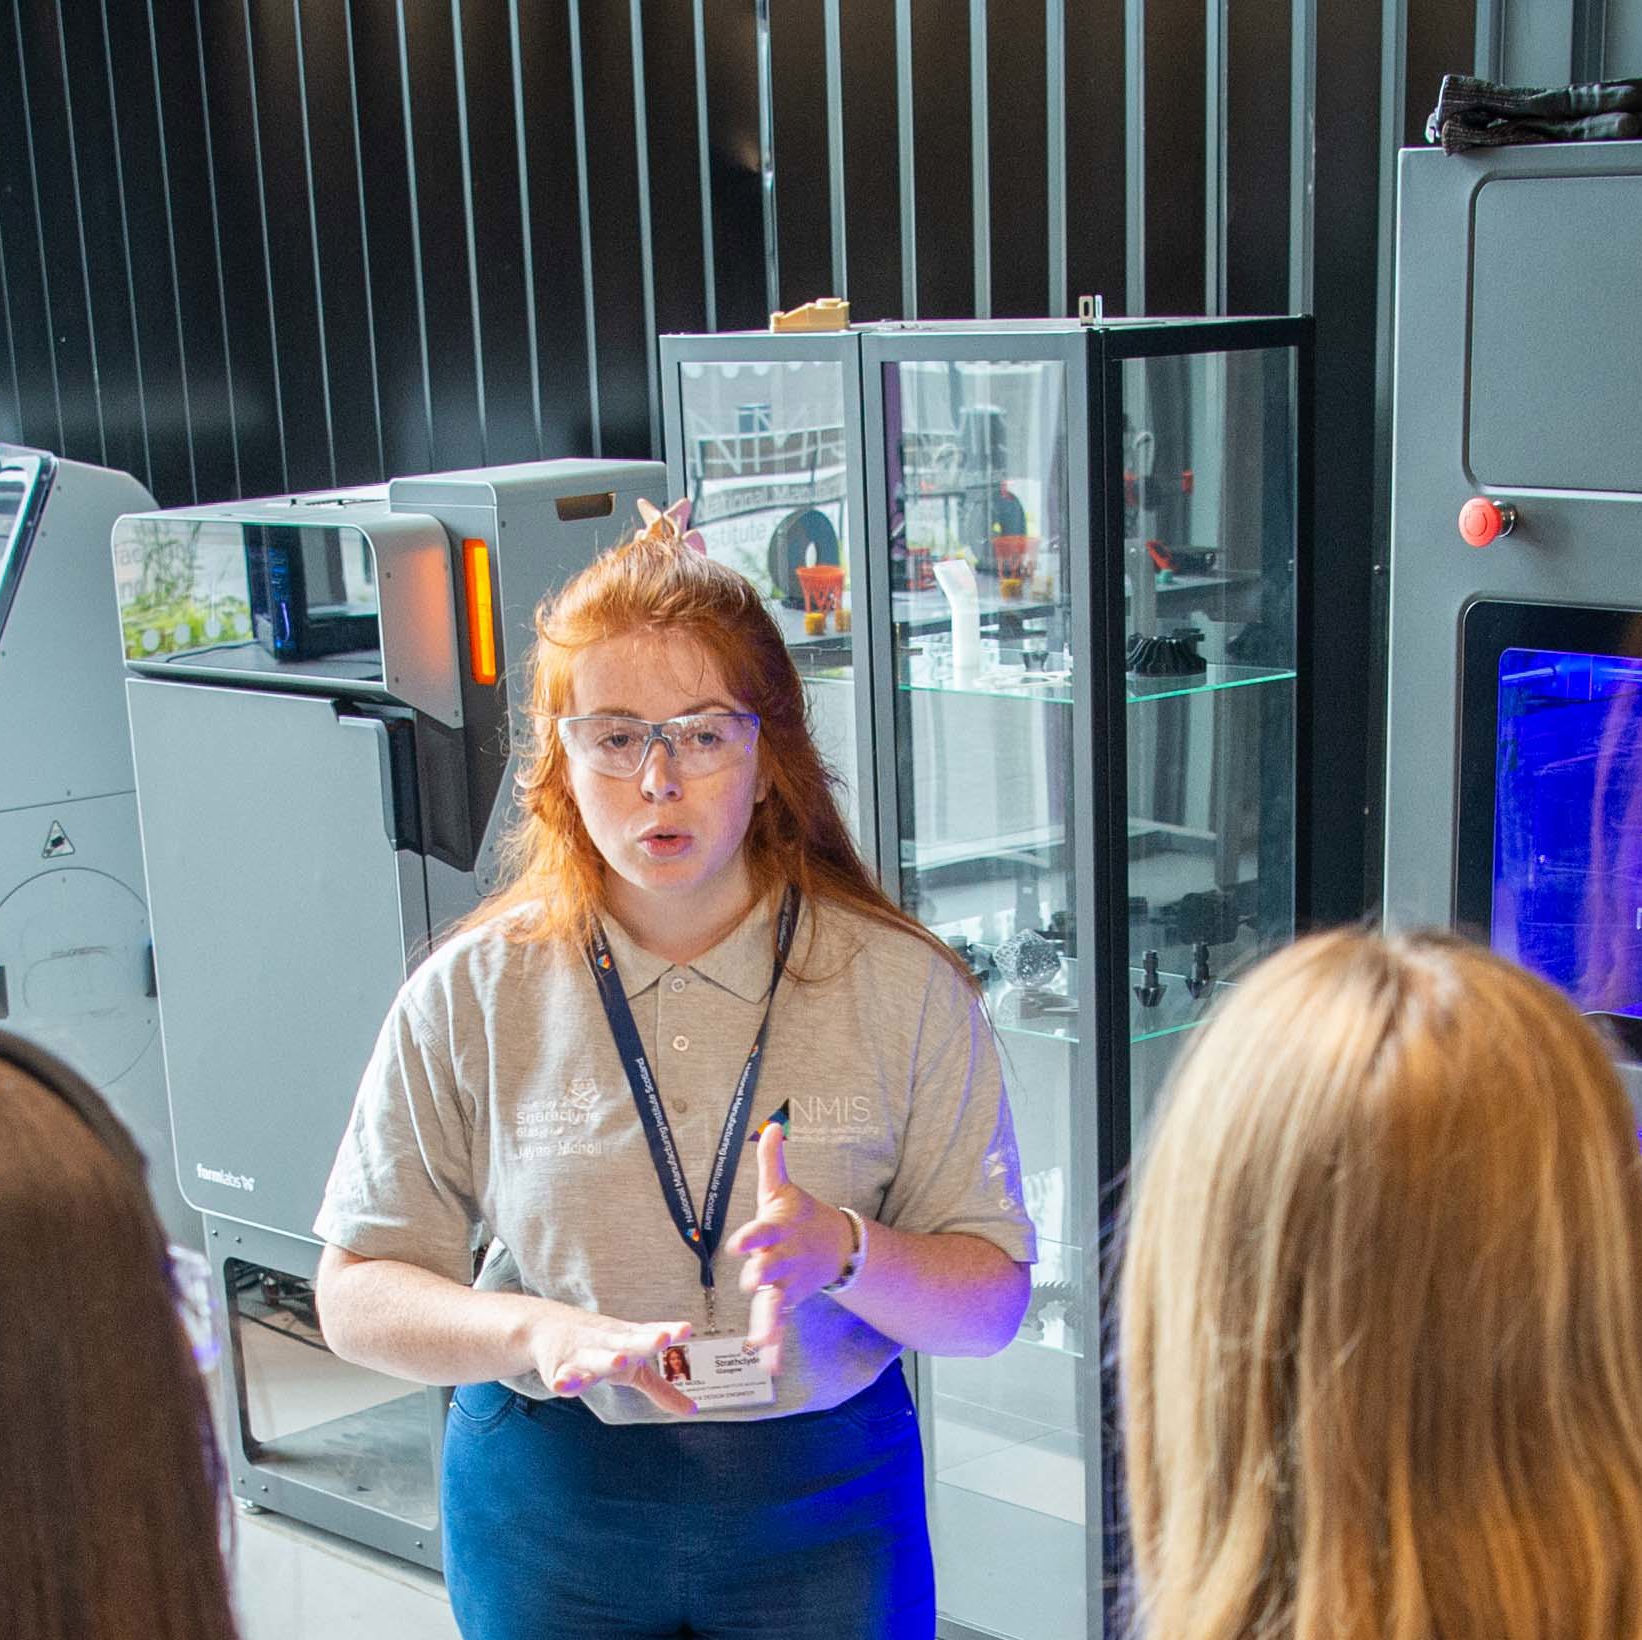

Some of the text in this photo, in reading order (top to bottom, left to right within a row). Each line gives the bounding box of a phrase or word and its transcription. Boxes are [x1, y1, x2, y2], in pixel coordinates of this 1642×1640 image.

[790, 1095, 871, 1123] NMIS
[719, 1097, 743, 1156] Manufacturing
[197, 1162, 242, 1189] formlabs
[712, 1156, 727, 1190] Institute
[704, 1190, 718, 1231] Scotland
